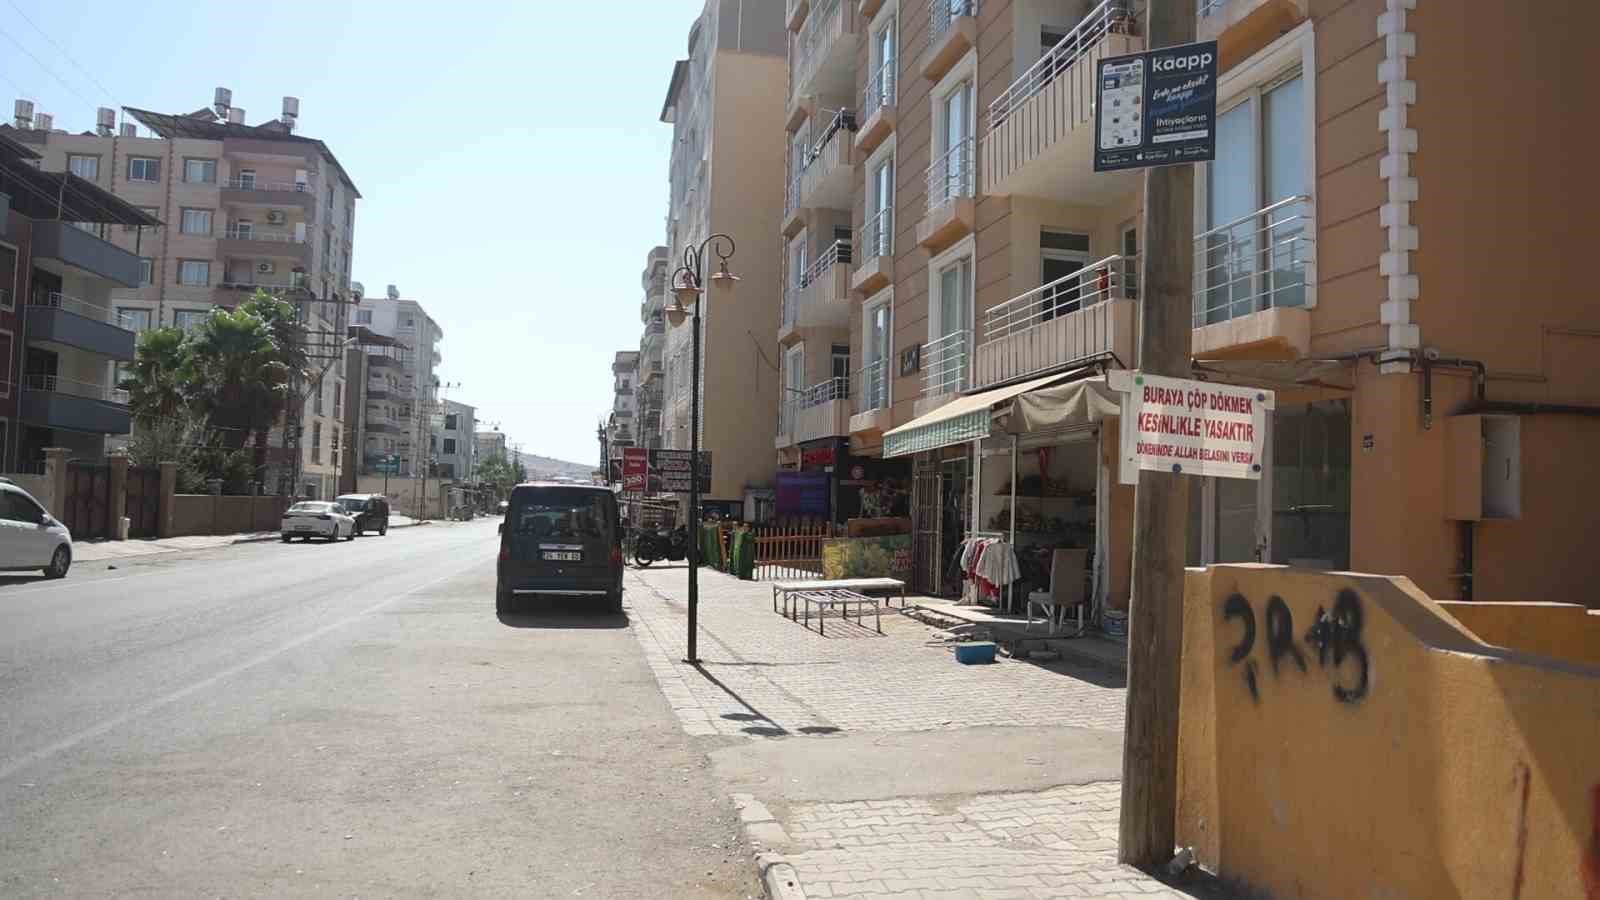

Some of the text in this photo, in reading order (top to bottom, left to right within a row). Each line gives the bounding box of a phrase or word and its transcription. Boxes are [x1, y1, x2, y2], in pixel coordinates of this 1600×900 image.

[1152, 52, 1213, 74] kaapp
[1143, 386, 1253, 415] BURAYA ÇÖP DÖKMEK
[1137, 412, 1254, 442] KESİNLİKLE YASAKTIR
[1174, 444, 1198, 460] ALLAH
[1199, 448, 1230, 462] BELASINI
